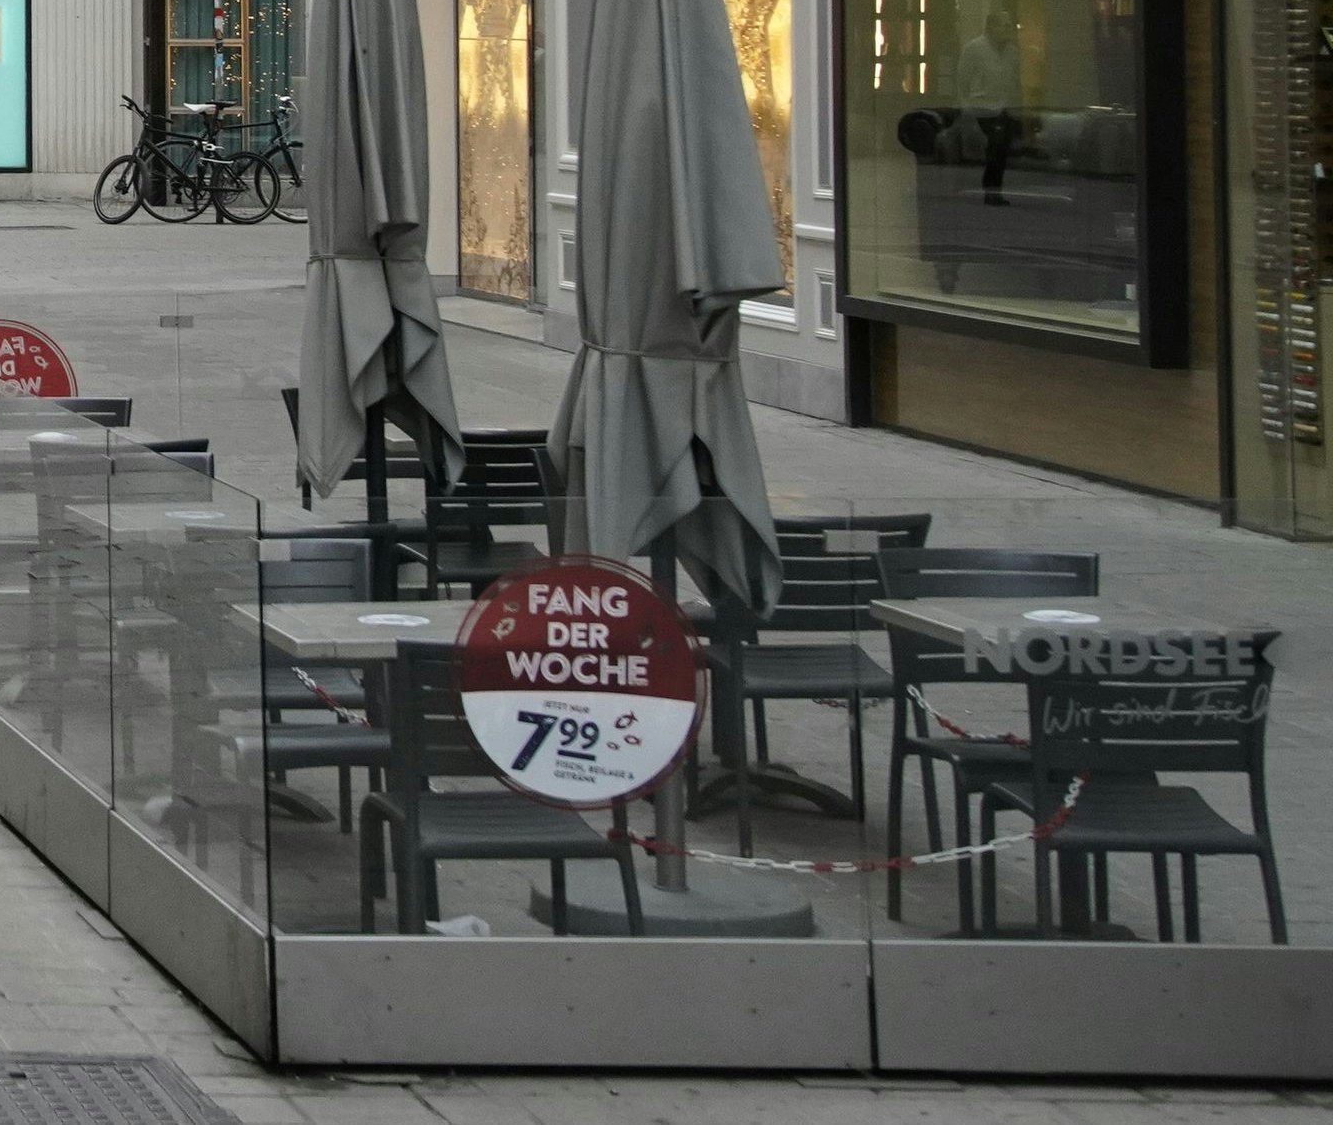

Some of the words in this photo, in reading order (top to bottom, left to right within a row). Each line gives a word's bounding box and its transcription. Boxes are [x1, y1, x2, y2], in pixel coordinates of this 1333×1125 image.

[528, 583, 629, 618] FANG
[547, 621, 610, 649] DER
[963, 627, 1256, 676] NORDSEE
[506, 650, 650, 687] WOCHE
[1043, 695, 1094, 735] Wir
[1108, 689, 1177, 725] sind
